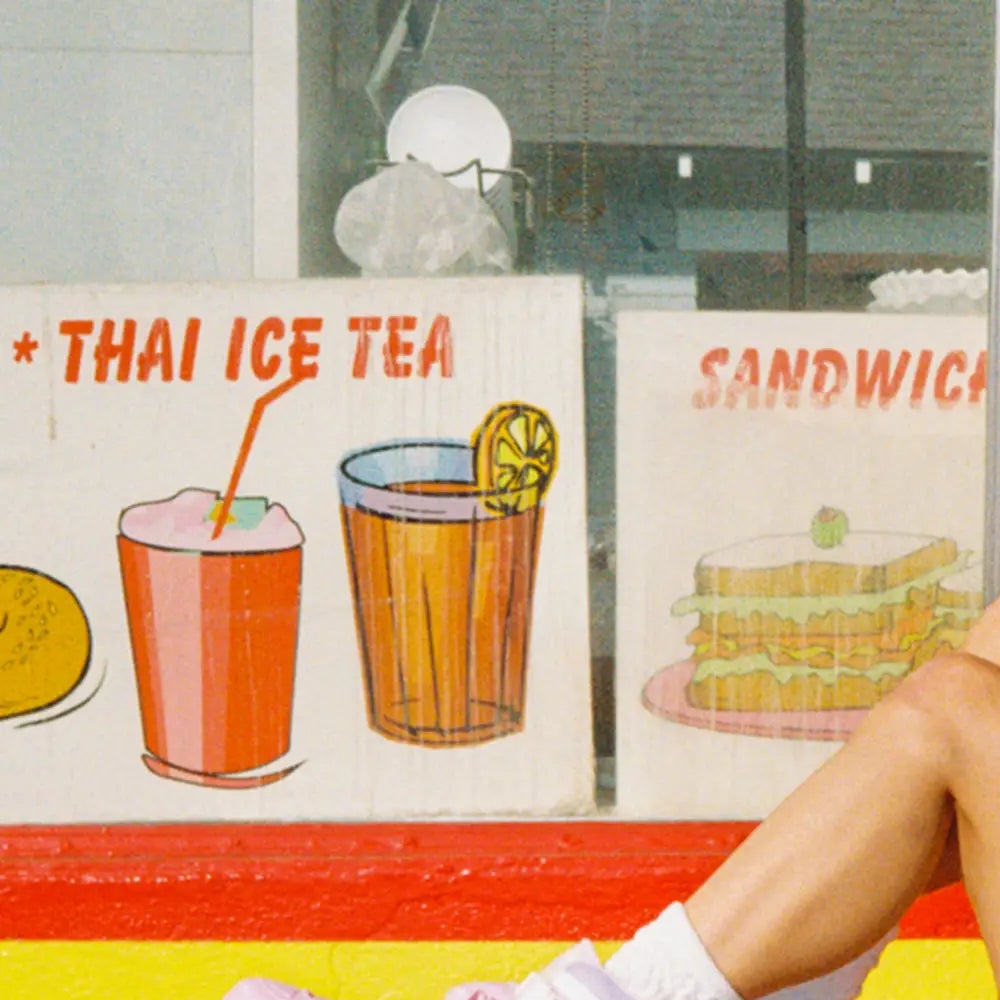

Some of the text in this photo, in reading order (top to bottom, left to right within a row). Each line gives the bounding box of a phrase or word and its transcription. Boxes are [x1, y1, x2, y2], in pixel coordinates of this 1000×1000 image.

[59, 314, 455, 383] THAI ICE TEA
